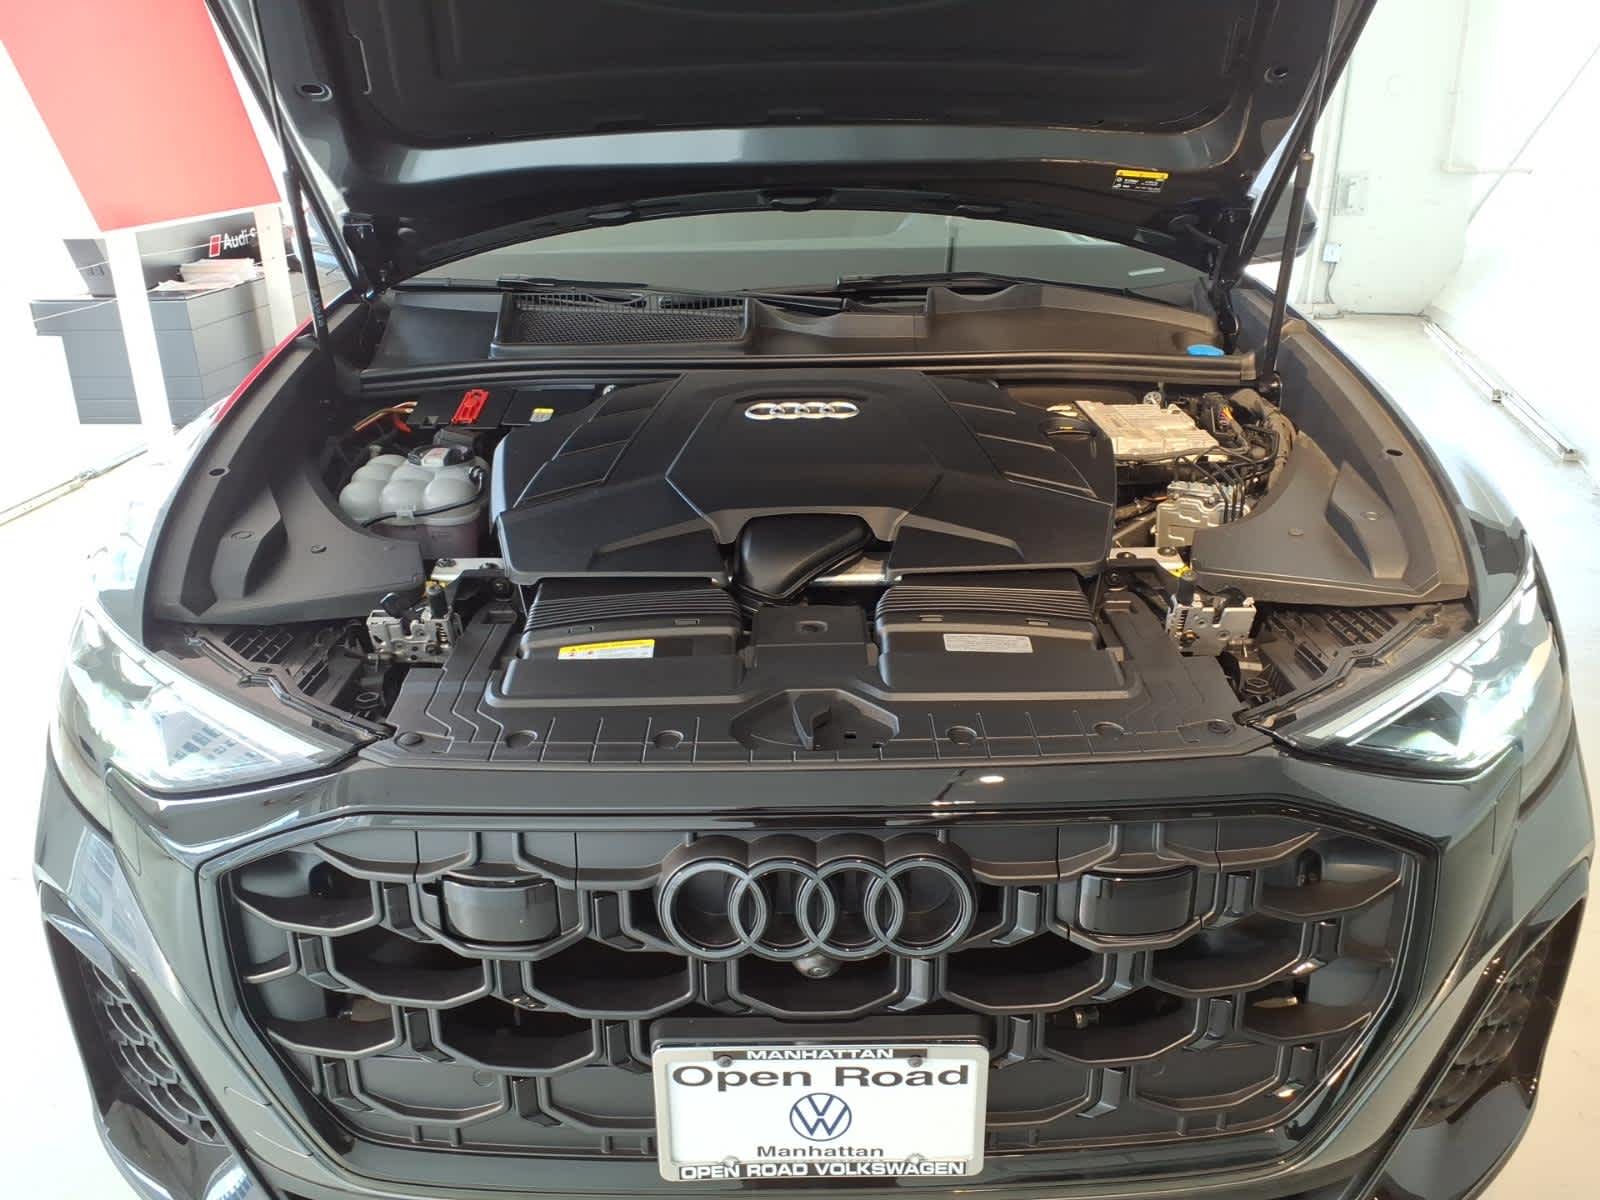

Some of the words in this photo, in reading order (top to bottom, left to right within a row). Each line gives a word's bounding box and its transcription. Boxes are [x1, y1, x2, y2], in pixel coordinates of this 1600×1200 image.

[223, 229, 248, 250] Audi
[746, 1048, 894, 1060] MANHATTAN
[672, 1065, 812, 1092] Open
[835, 1064, 969, 1087] Road
[756, 1145, 884, 1158] Manhattan
[680, 1164, 740, 1180] OPEN
[746, 1163, 808, 1178] ROAD
[814, 1161, 965, 1176] VOLKSWAGEN
